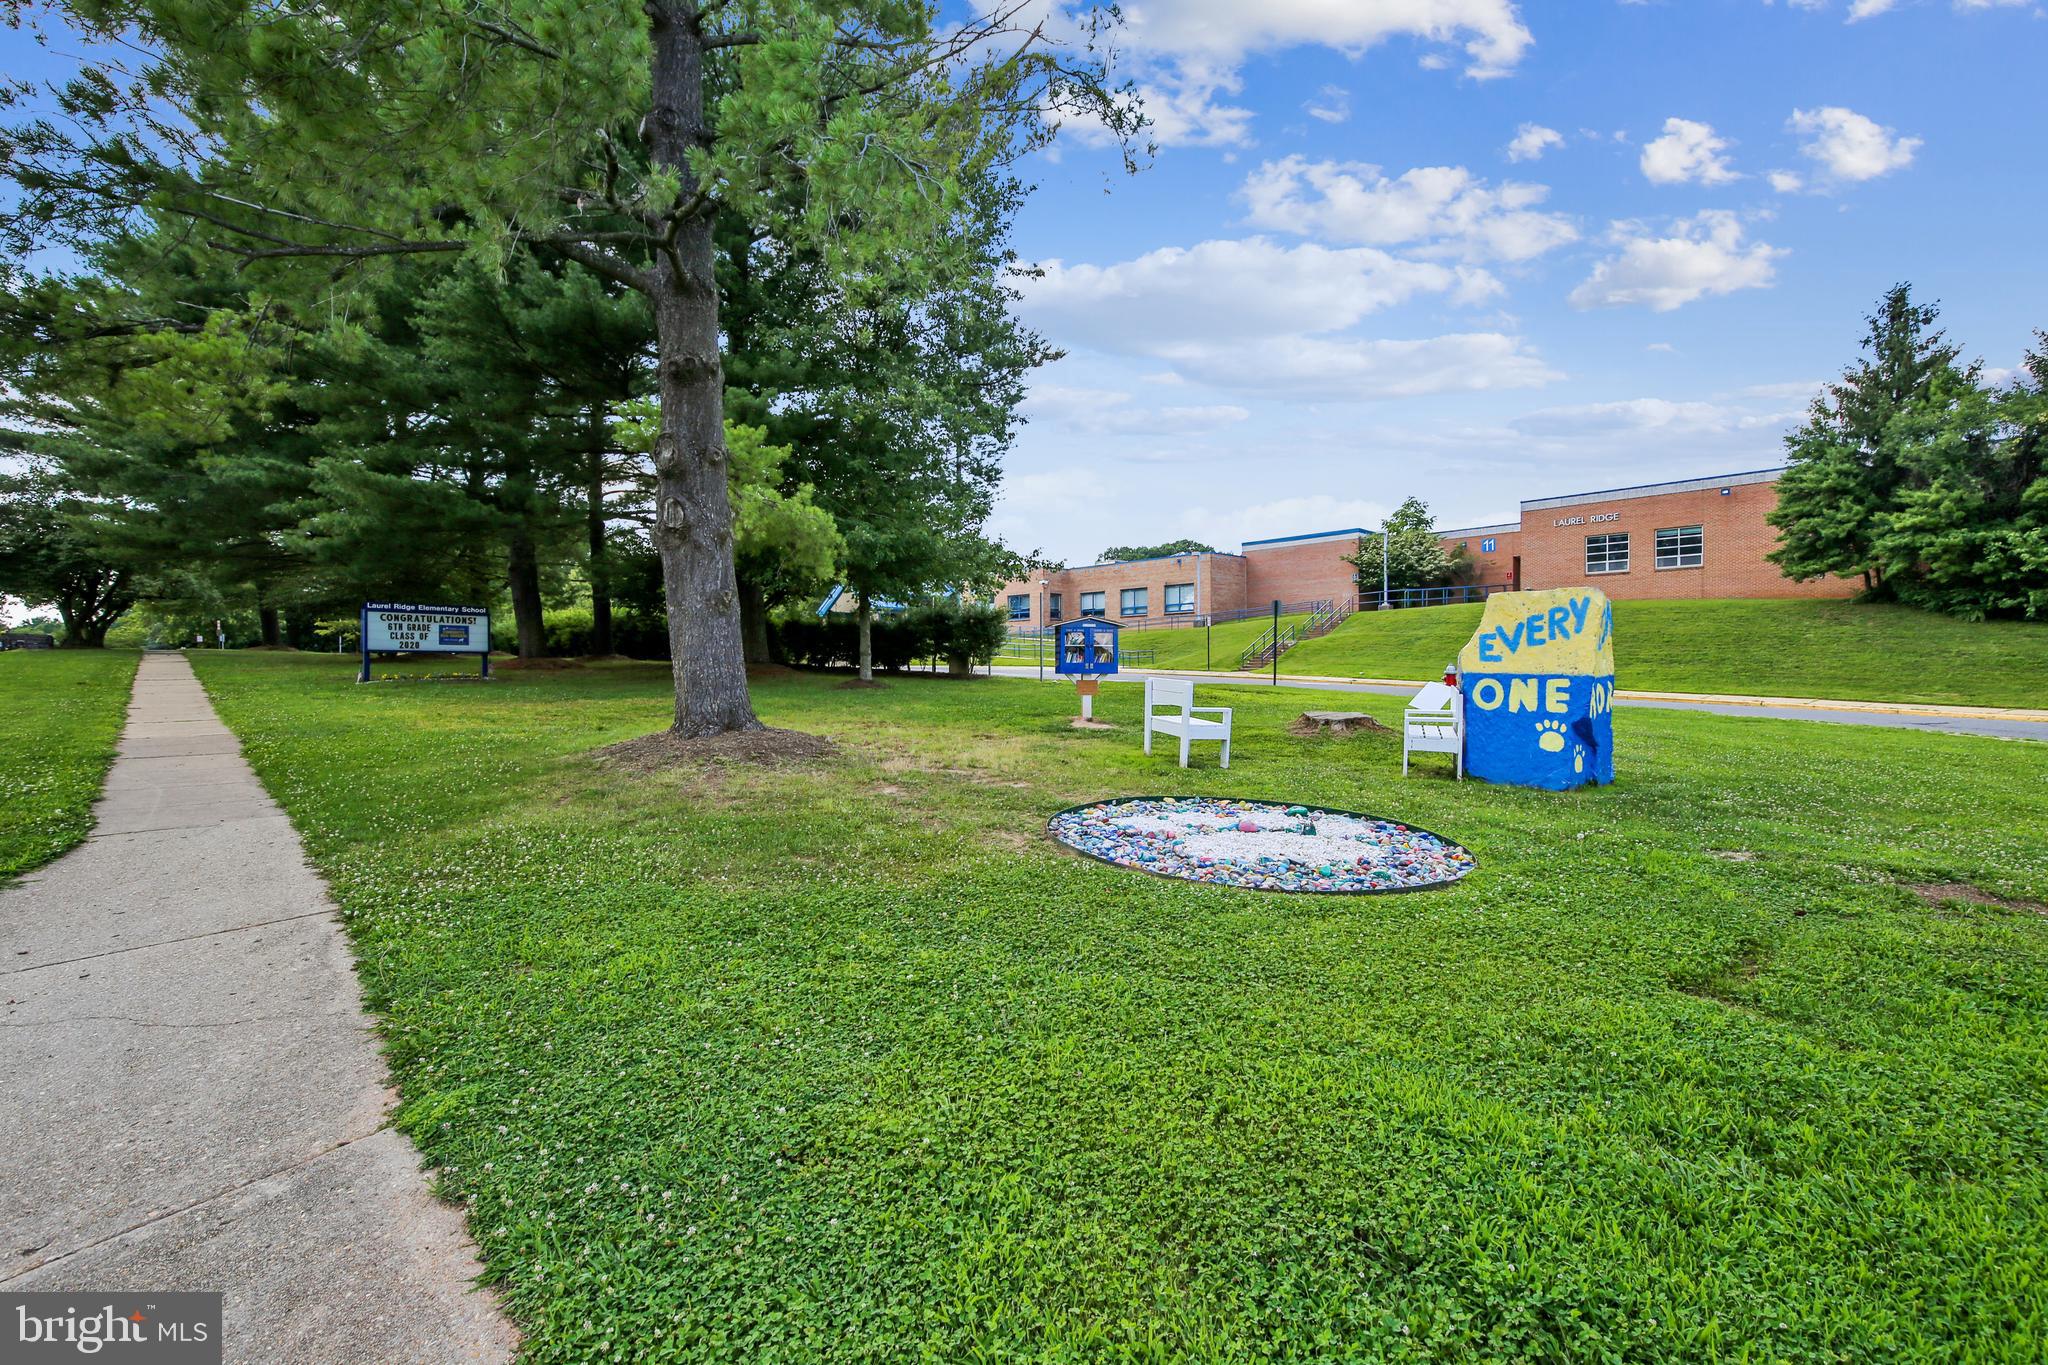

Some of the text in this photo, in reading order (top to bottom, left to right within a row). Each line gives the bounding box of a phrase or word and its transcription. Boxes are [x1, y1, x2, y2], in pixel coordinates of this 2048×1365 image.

[1553, 512, 1620, 527] LAUREL RIDGE
[1483, 539, 1495, 551] 11
[393, 603, 416, 611] Ridge
[418, 604, 459, 613] Elementary
[380, 613, 477, 625] CONGRATULATIONS!
[388, 623, 431, 632] 6TH GRADE
[1478, 596, 1591, 662] EVERY
[390, 632, 415, 640] CLASS
[399, 641, 420, 649] 2020
[1472, 678, 1571, 714] ONE
